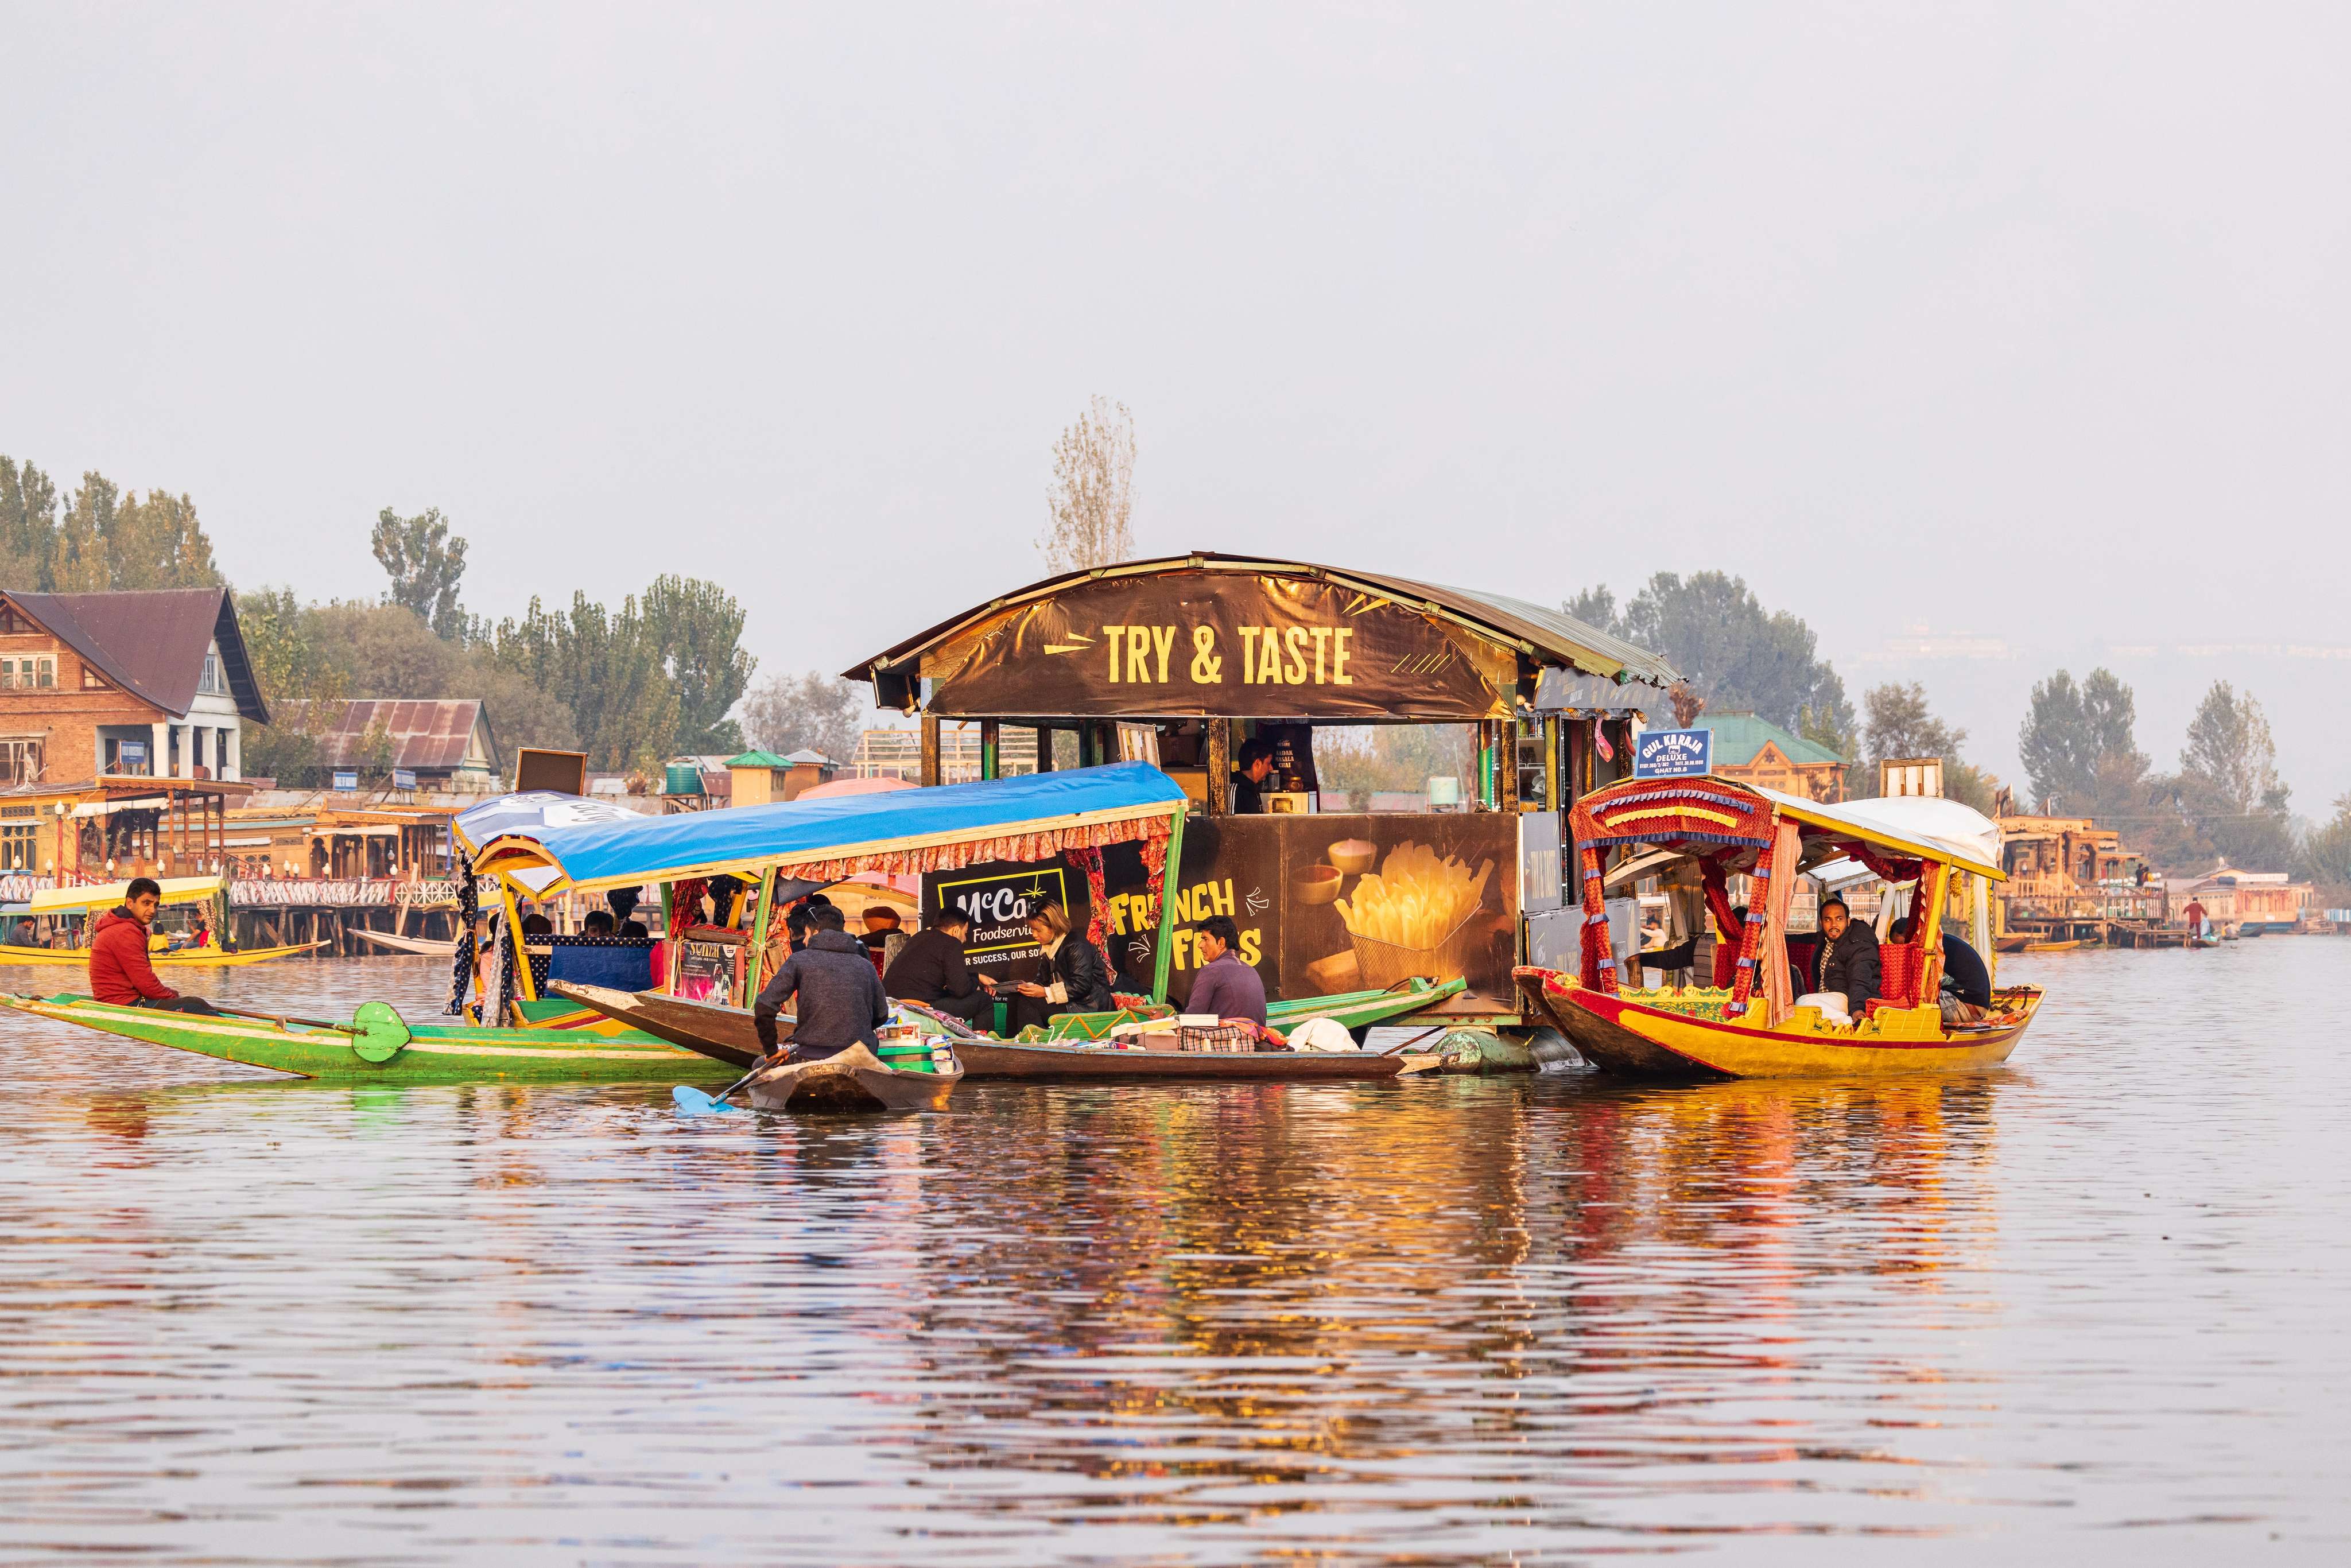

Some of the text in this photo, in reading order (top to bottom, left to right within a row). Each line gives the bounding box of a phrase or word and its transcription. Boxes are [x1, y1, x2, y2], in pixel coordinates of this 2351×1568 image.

[1102, 625, 1353, 685] TRY & TASTE
[1642, 739, 1663, 758] GUL
[1656, 753, 1687, 762] DELUXE
[957, 888, 1027, 923] McCa
[1108, 878, 1235, 936] FRNCH
[973, 953, 1010, 965] SUCCESS,
[1011, 950, 1027, 960] OUR
[1171, 928, 1262, 971] FRS
